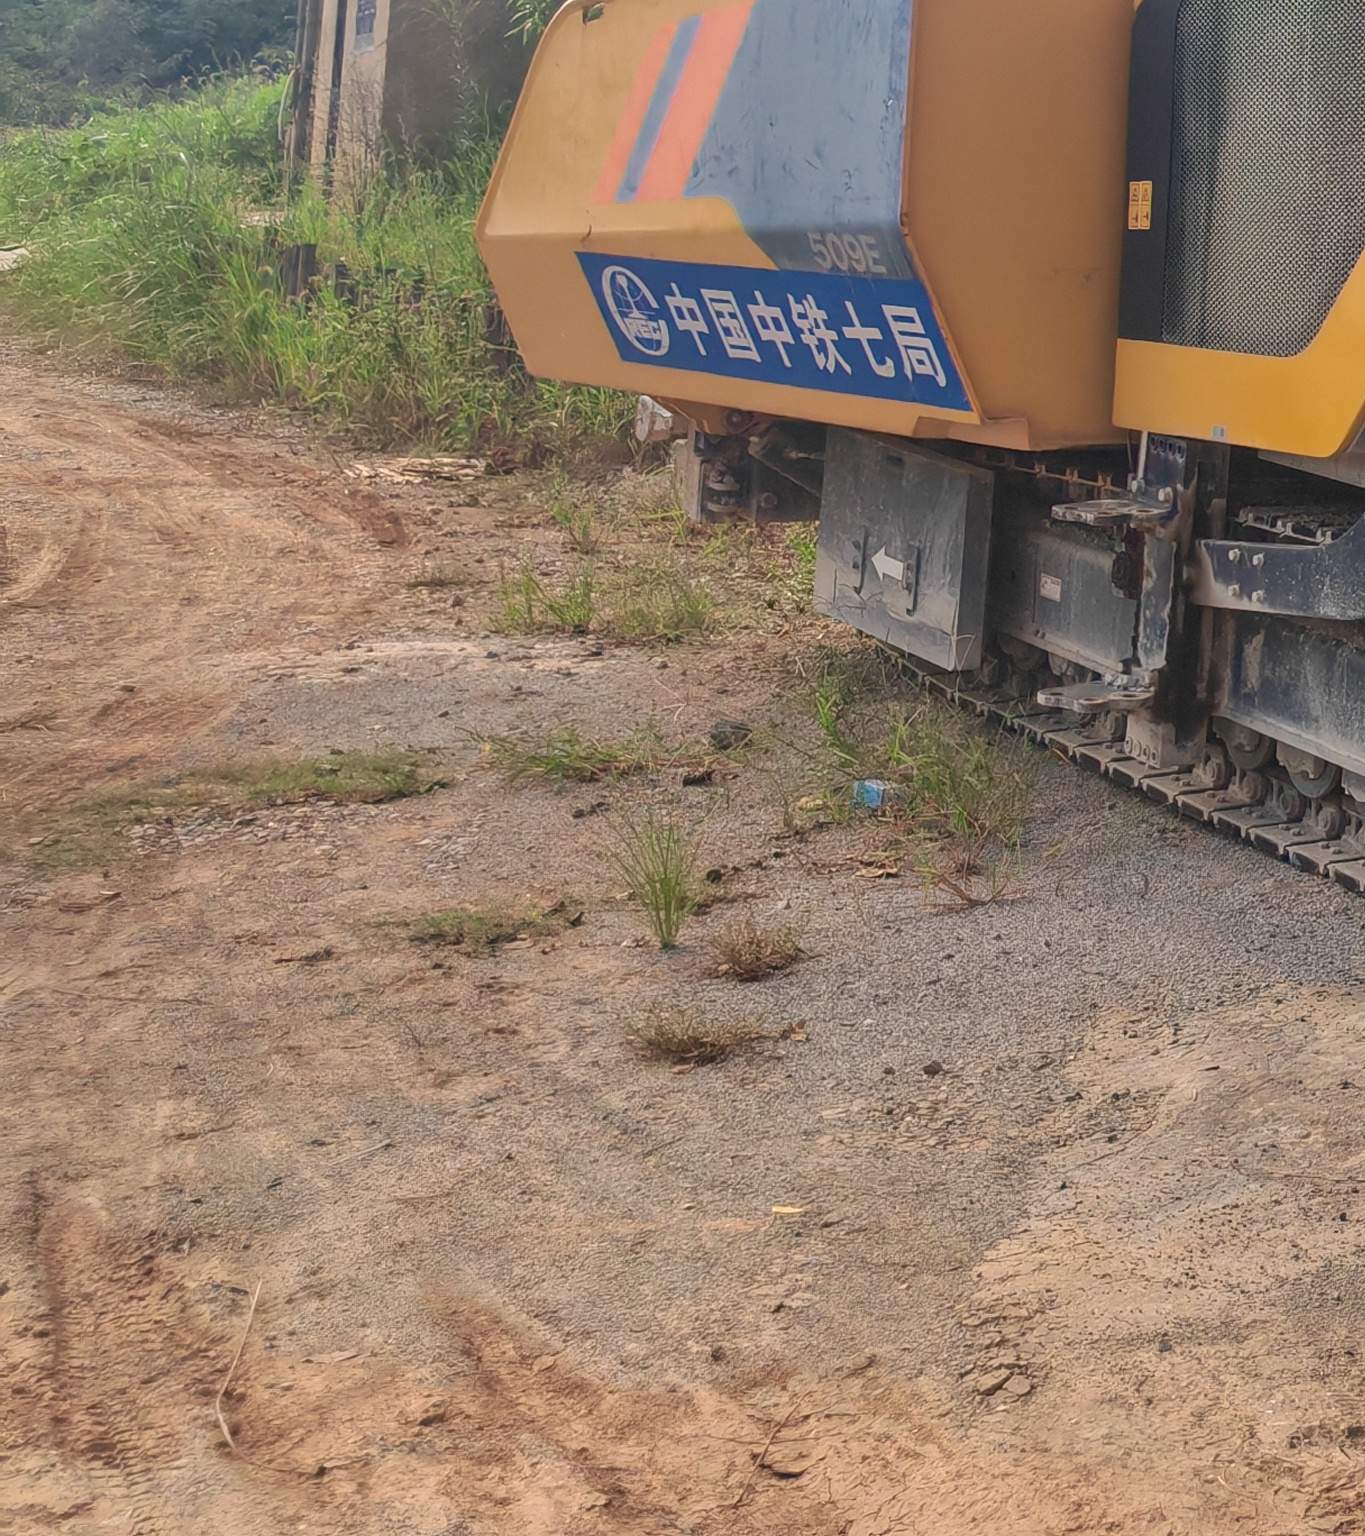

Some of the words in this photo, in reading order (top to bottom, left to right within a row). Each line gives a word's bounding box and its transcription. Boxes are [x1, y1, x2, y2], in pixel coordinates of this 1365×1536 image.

[806, 231, 888, 274] 509E
[664, 282, 947, 388] 中国中铁七局
